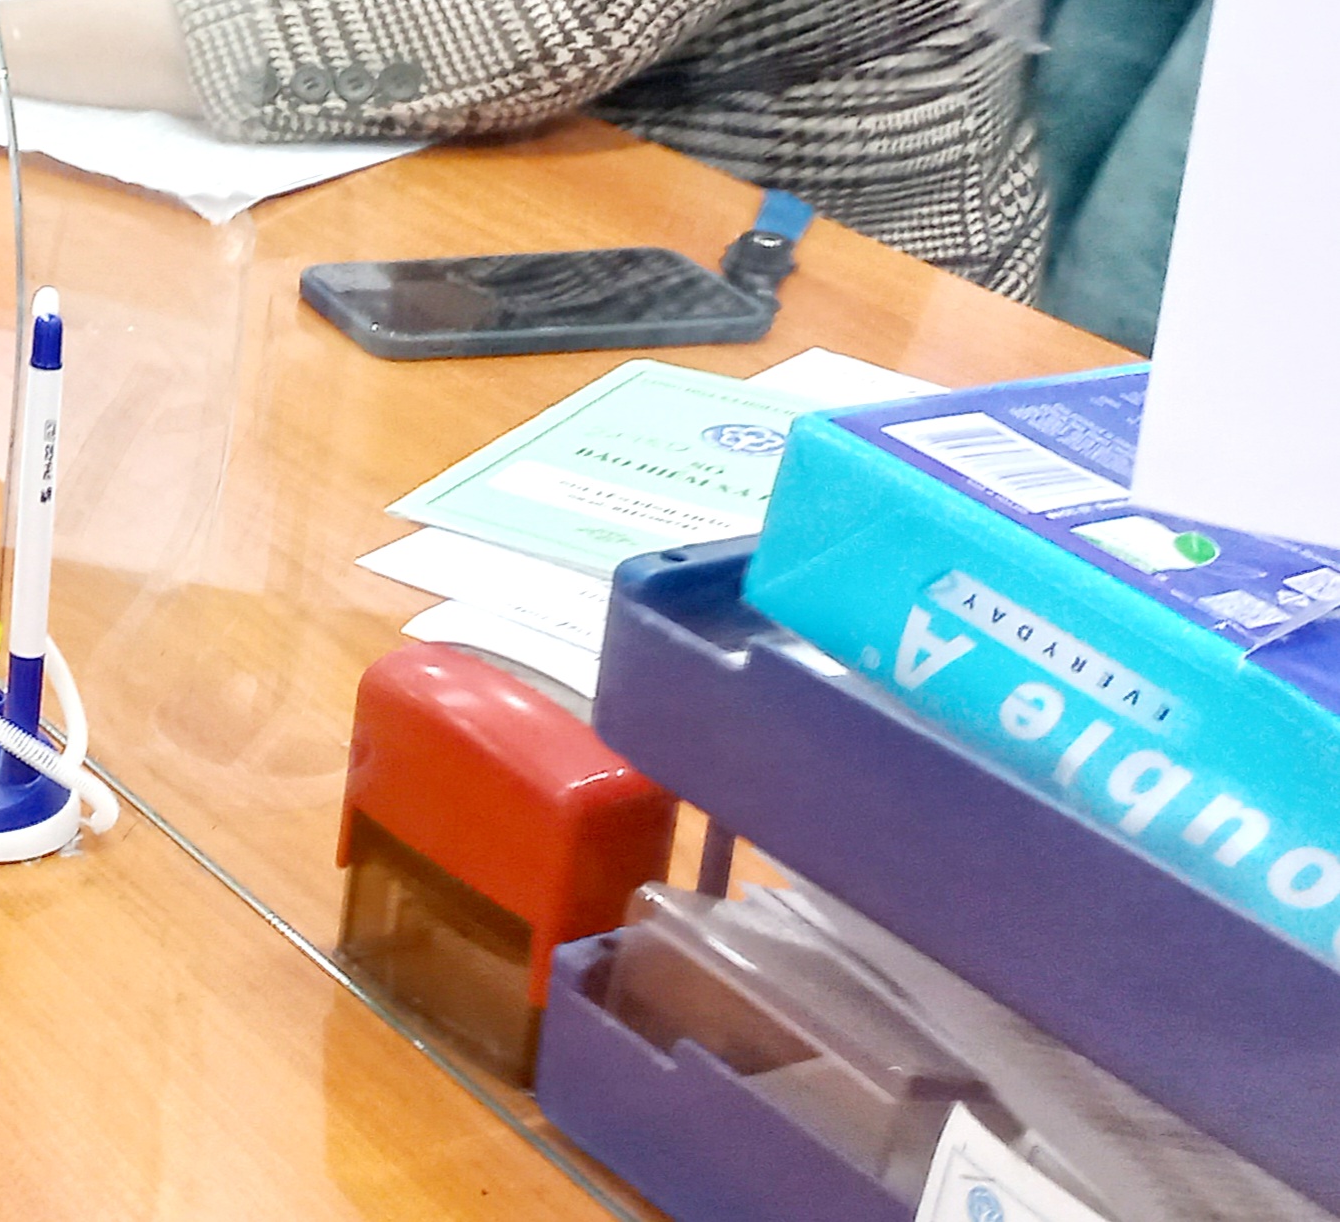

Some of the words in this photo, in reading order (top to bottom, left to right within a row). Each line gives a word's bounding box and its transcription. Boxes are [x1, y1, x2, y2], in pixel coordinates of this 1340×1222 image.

[893, 605, 977, 691] A
[962, 593, 1170, 722] EVERYDAY
[999, 682, 1340, 963] ouble
